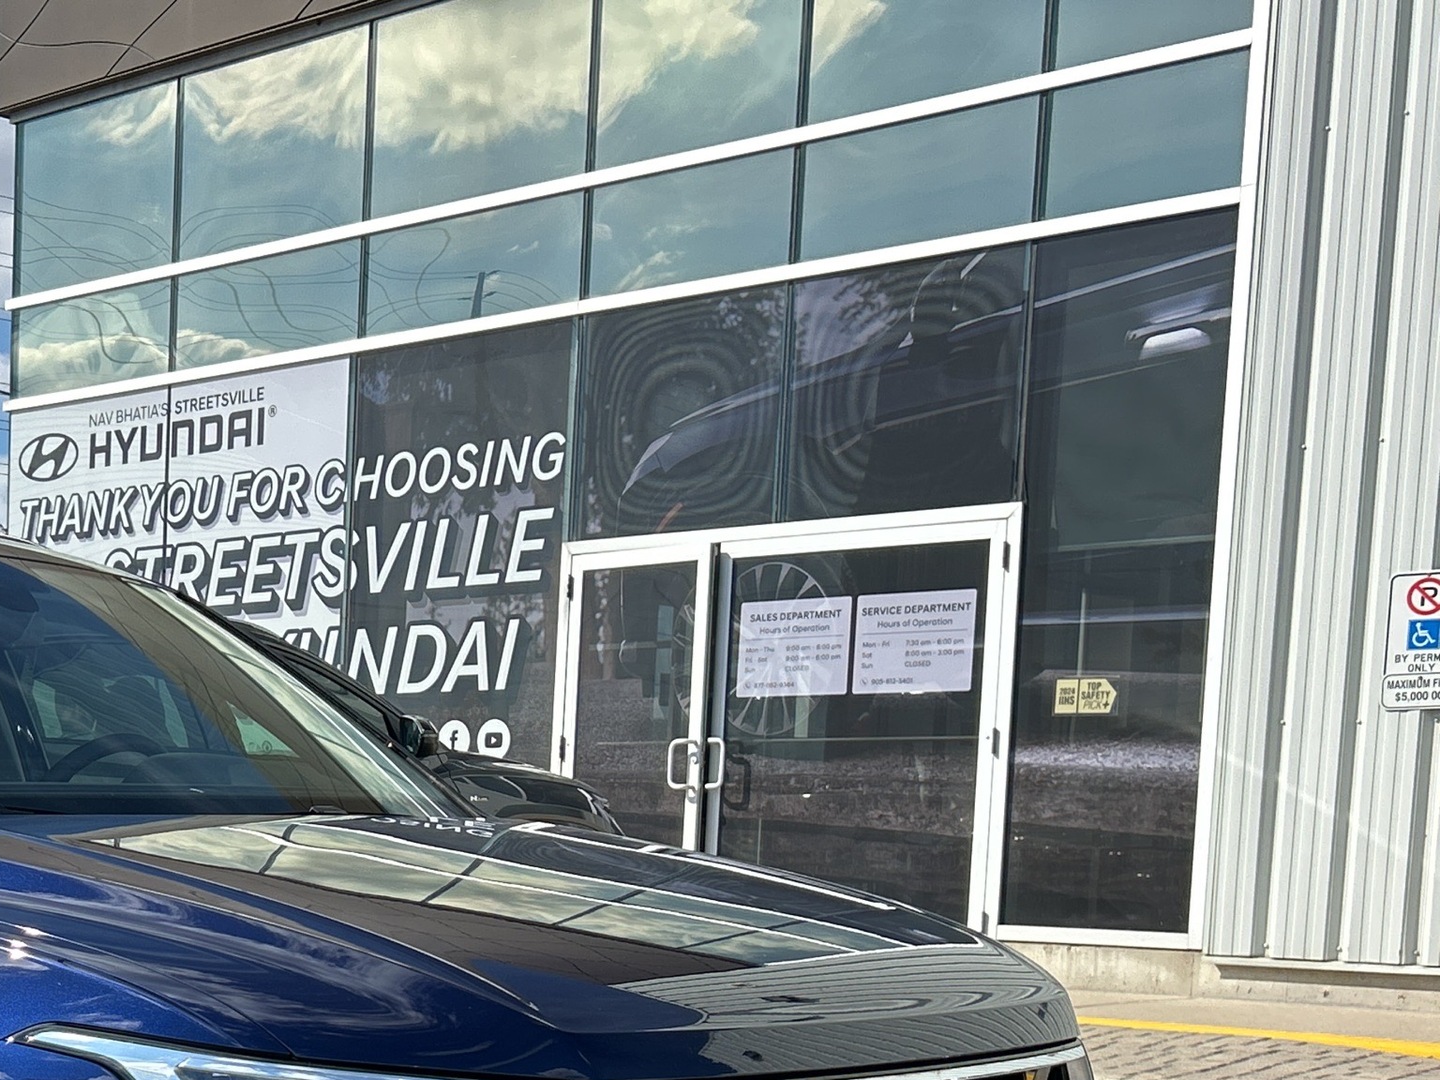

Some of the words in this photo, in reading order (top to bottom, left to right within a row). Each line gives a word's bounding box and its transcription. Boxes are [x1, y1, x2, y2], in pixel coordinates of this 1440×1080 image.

[89, 410, 113, 427] NAV
[116, 402, 169, 424] BHATIA'S
[174, 387, 265, 415] STREETSVILLE
[21, 486, 137, 541] THANK
[141, 475, 221, 531] YOU
[227, 464, 309, 519] FOR
[315, 432, 566, 506] CHOOSING
[862, 606, 902, 616] SERVICE
[904, 602, 971, 614] DEPARTMENT
[750, 613, 778, 622] SALES
[780, 609, 842, 621] DEPARTMENT
[877, 620, 901, 628] Hours
[902, 619, 911, 627] of
[912, 617, 953, 628] Operation
[760, 626, 781, 634] Hours
[783, 625, 791, 633] of
[792, 624, 830, 634] Operation
[1394, 653, 1409, 664] BY
[1407, 663, 1436, 673] ONLY
[1087, 681, 1102, 691] TOP
[1387, 678, 1431, 690] MAXIMUM
[1081, 690, 1111, 700] SAFETY
[1395, 691, 1429, 703] $5,000
